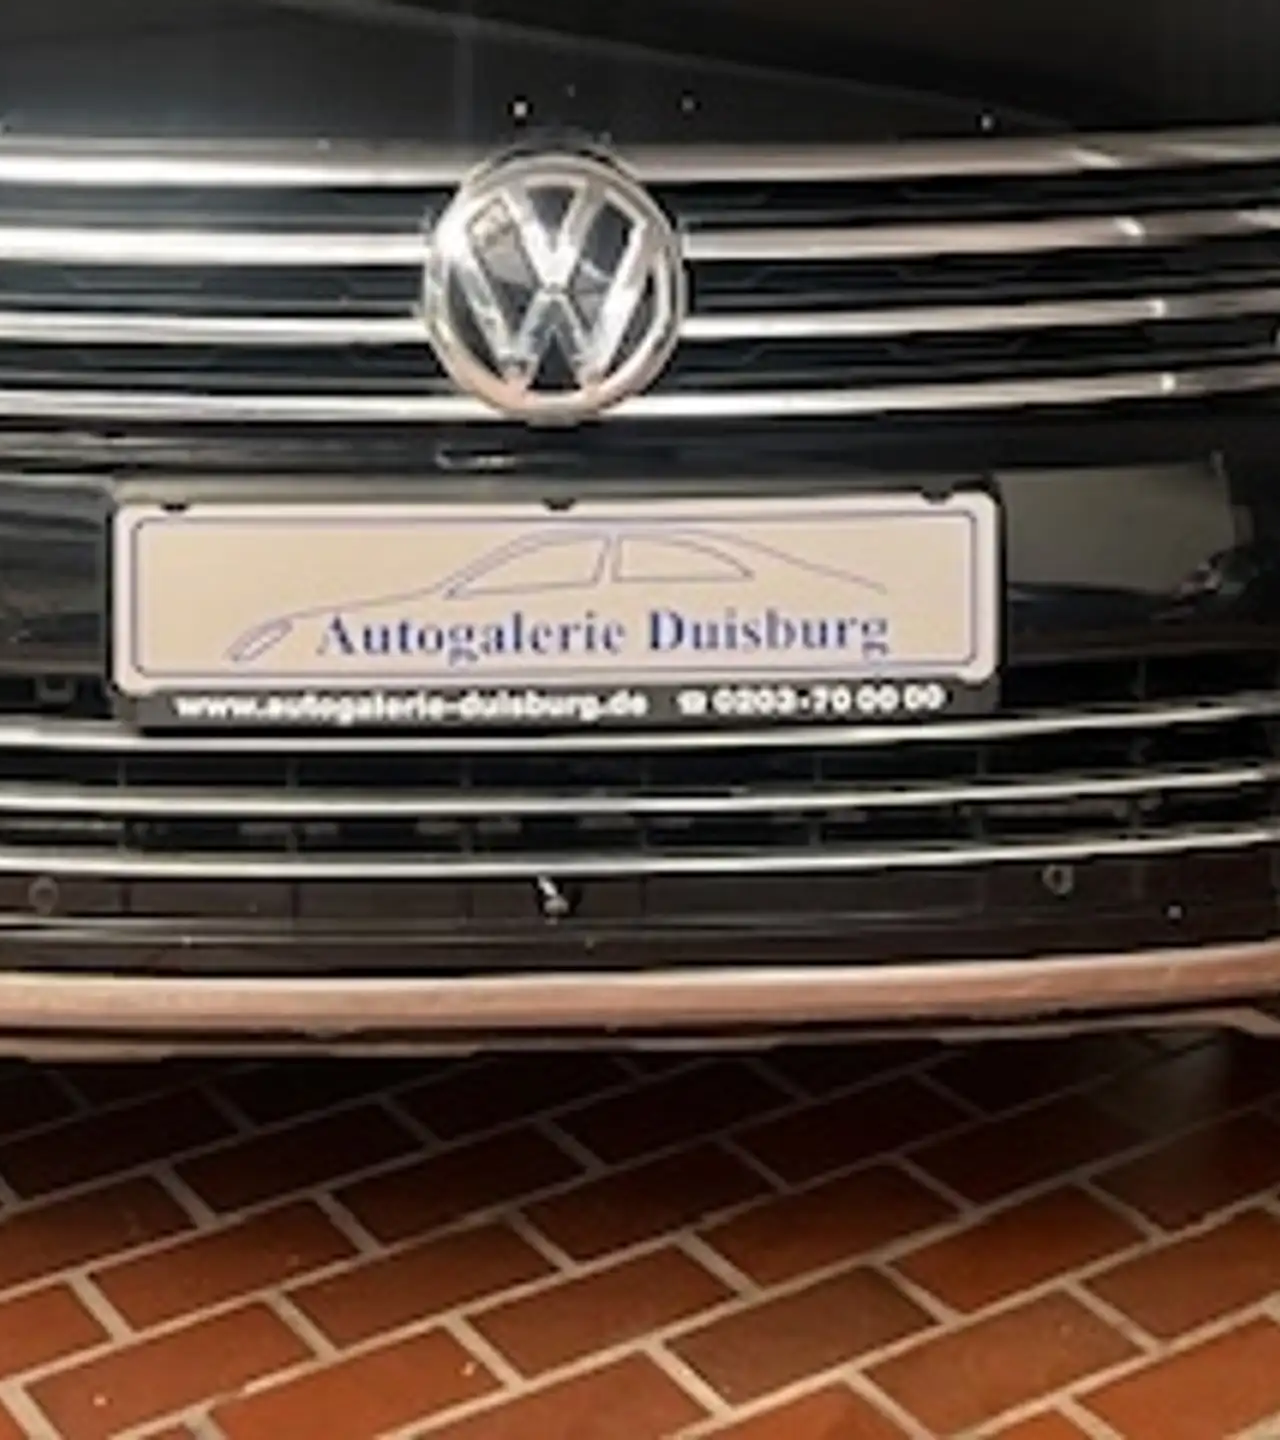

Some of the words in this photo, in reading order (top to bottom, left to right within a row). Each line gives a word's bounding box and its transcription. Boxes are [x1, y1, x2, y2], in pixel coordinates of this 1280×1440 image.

[430, 162, 675, 406] VW
[317, 610, 626, 667] Autogalerie
[647, 606, 890, 660] Duisburg
[173, 688, 648, 723] www.autogalerie-duisburg.de
